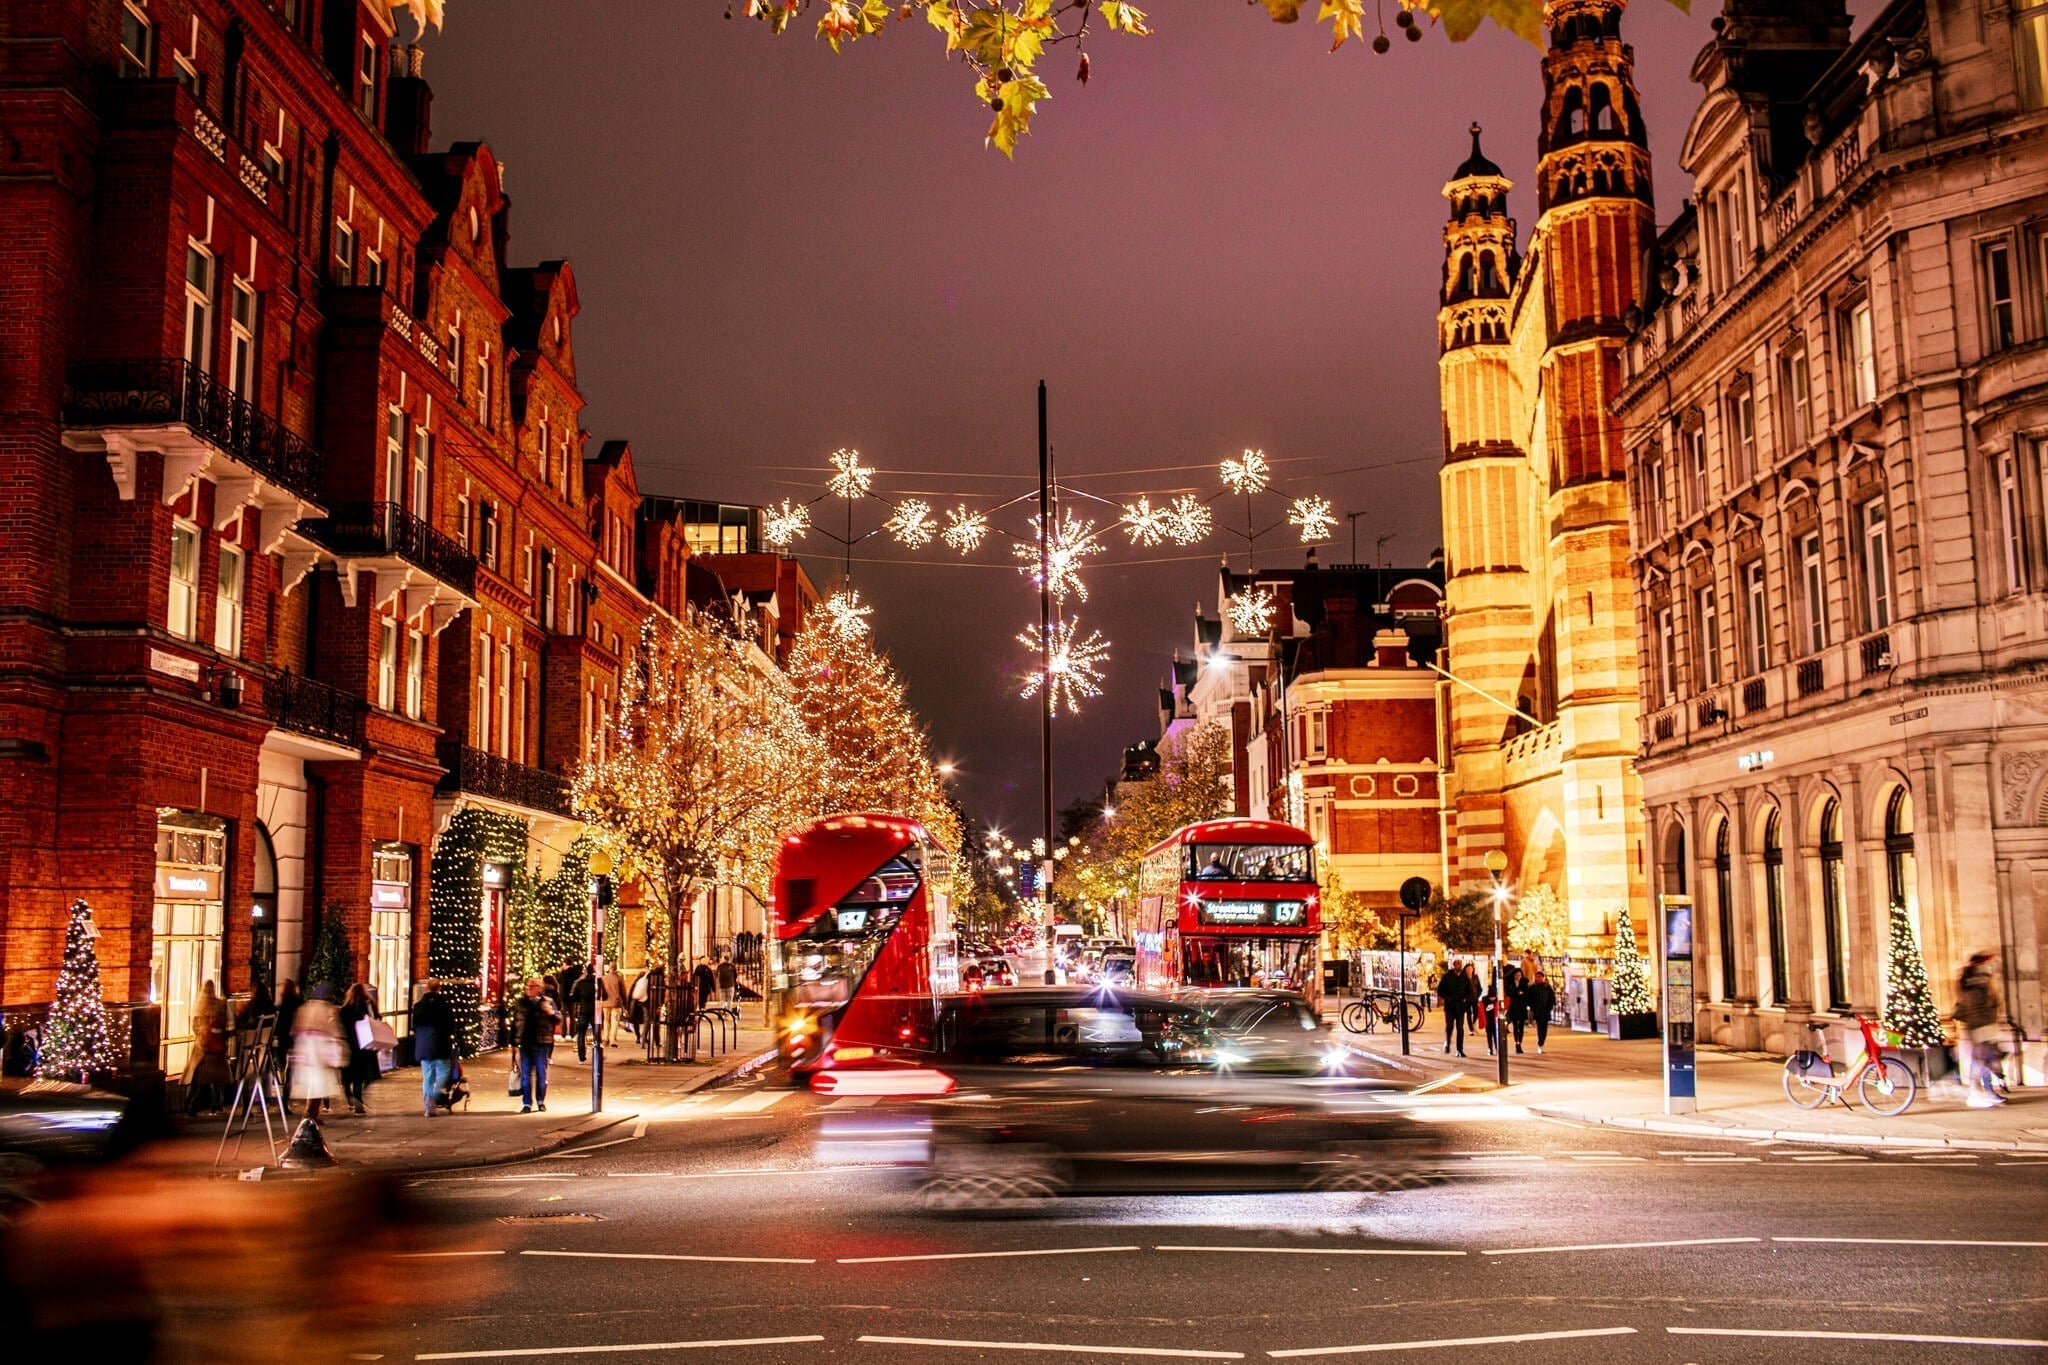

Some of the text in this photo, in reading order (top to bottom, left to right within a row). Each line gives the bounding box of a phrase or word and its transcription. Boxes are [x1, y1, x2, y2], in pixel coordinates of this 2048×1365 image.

[1206, 903, 1265, 914] Streatham Hill
[1276, 902, 1300, 921] 137
